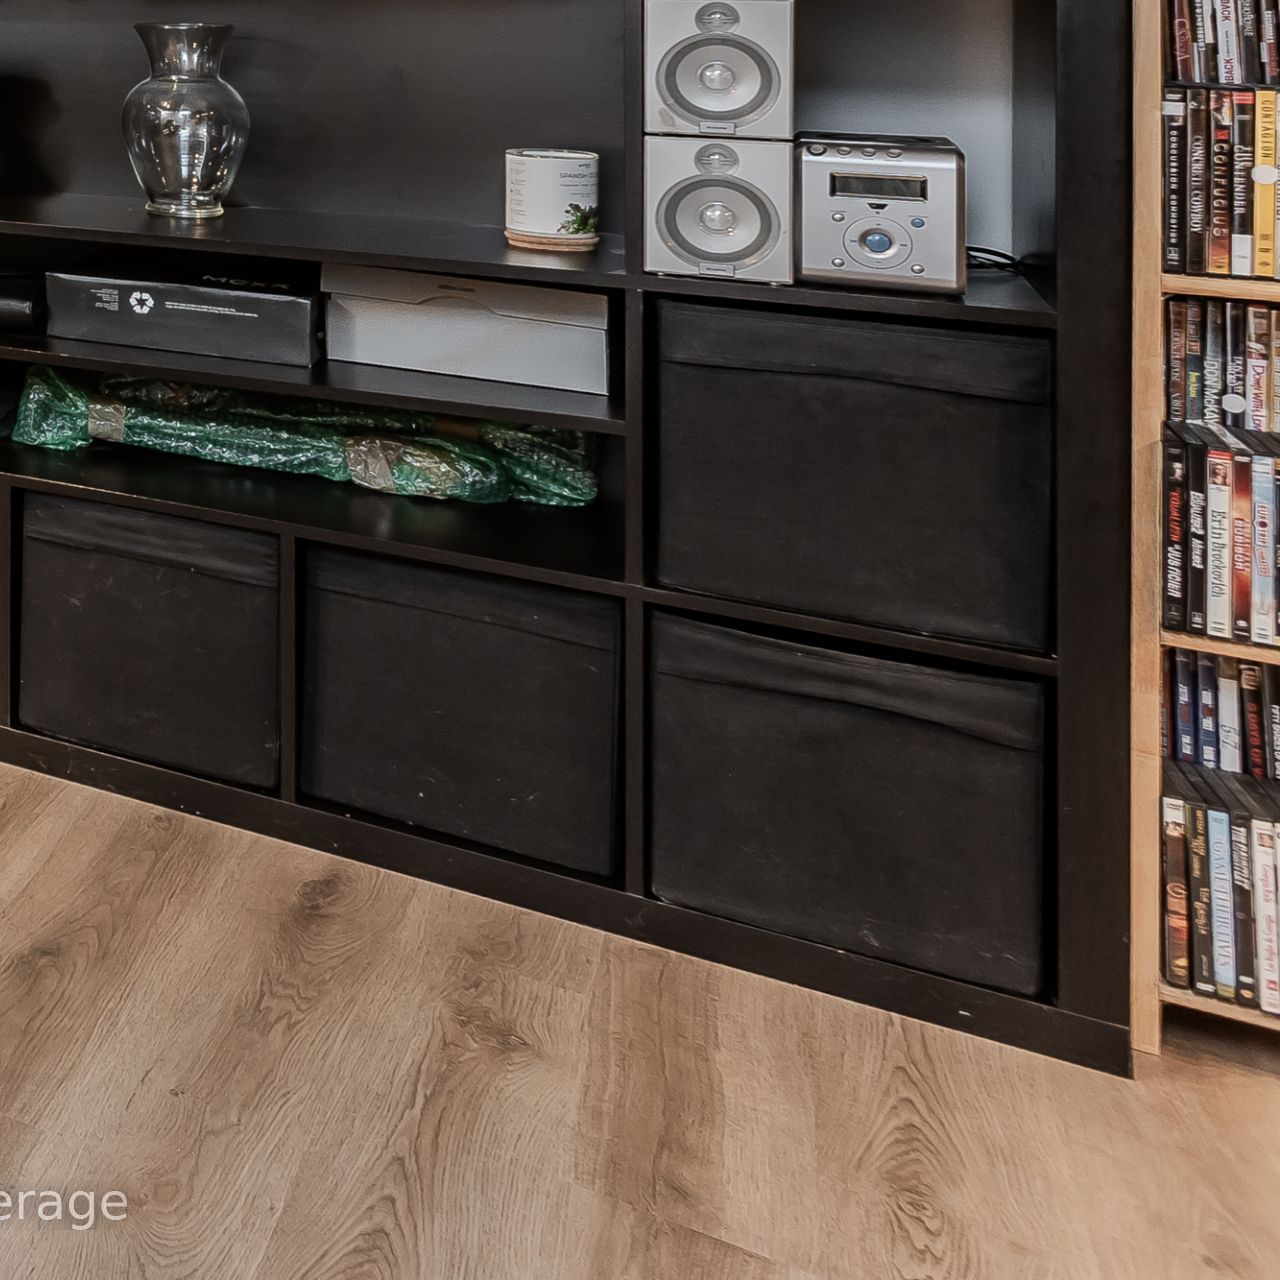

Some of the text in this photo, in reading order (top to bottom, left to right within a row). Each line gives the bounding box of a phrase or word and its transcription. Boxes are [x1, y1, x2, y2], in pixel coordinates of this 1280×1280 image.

[1261, 100, 1272, 158] CONTAGION
[1170, 130, 1179, 244] CONCUSSION COMMOTION
[1212, 142, 1229, 237] CONFUCIUS
[1234, 144, 1247, 215] CONTENDER
[1190, 190, 1205, 234] COWBOY
[1203, 361, 1221, 424] DON McKAY
[1211, 510, 1227, 539] Erin
[1231, 826, 1250, 890] THE GAUNTLET
